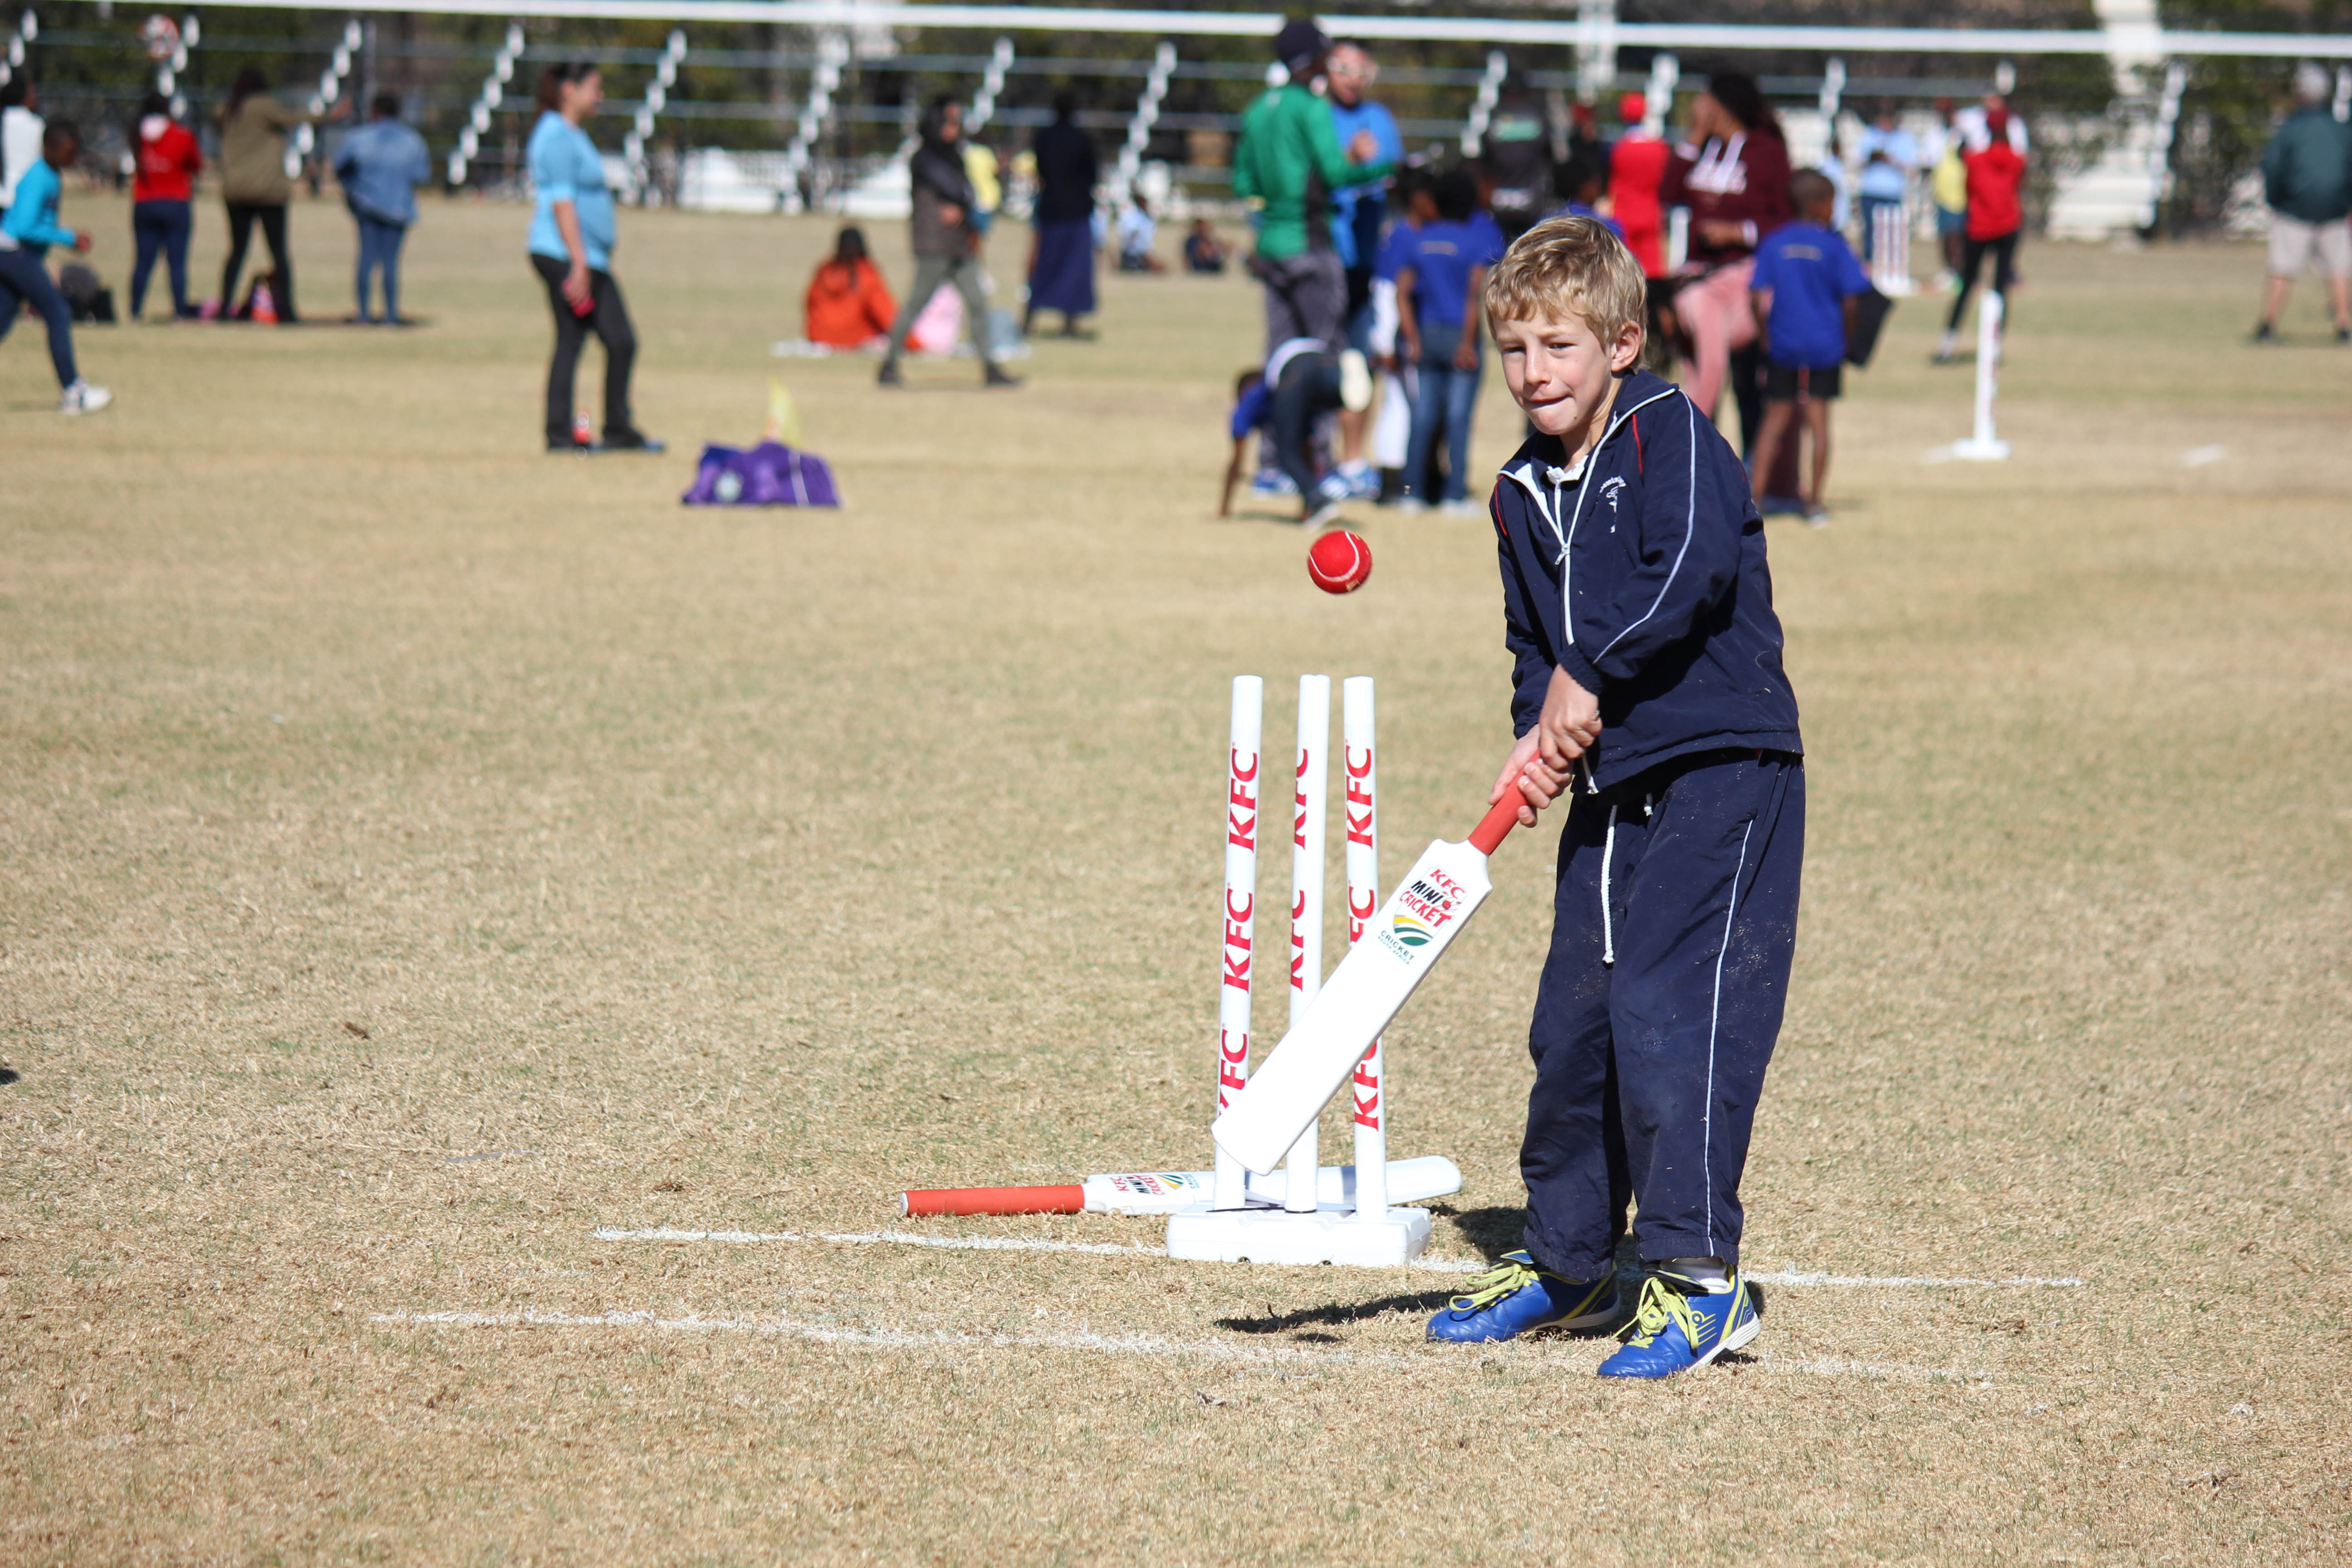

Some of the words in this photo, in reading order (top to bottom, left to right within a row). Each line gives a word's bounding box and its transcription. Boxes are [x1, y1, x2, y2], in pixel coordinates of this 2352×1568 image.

[1228, 748, 1258, 853] KFC
[1345, 745, 1373, 850] KFC
[1411, 880, 1444, 904] MINI
[1430, 868, 1465, 900] KFC
[1348, 886, 1375, 949] FC
[1400, 891, 1452, 927] CRICKET
[1224, 888, 1253, 994] KFC
[1381, 930, 1415, 960] CRICKET
[1110, 1176, 1130, 1191] KFC
